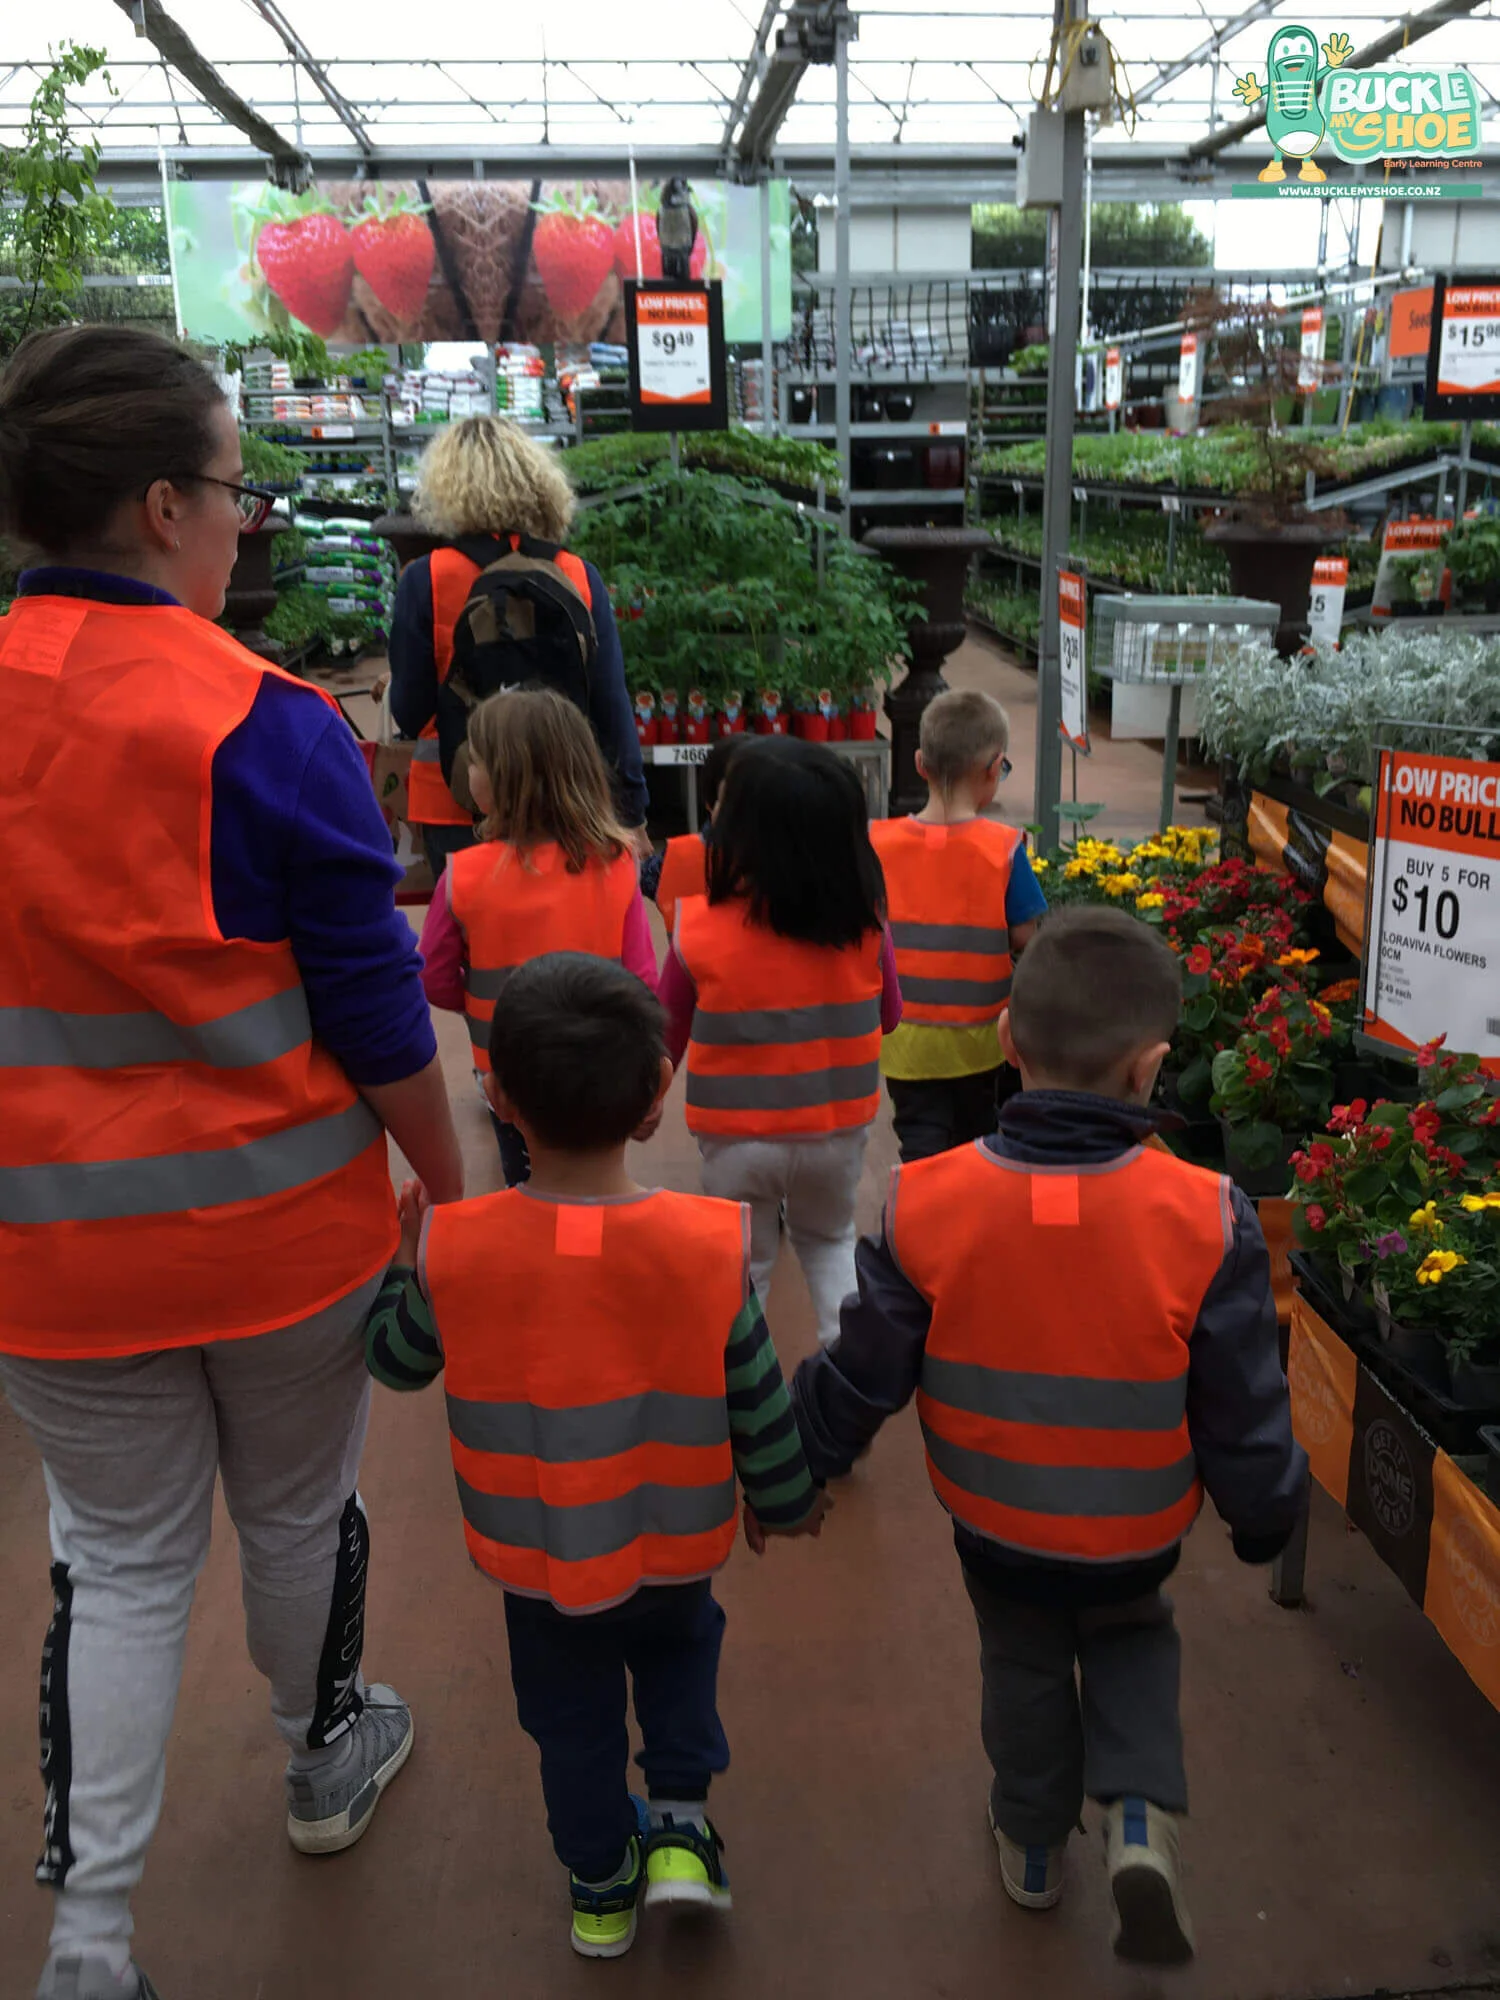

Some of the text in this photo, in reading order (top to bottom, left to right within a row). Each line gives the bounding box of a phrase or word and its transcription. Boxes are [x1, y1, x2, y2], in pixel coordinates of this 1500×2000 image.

[638, 296, 663, 309] LOW
[1384, 763, 1437, 798] LOW
[1401, 799, 1500, 842] NO BULL
[1406, 857, 1490, 892] BUY 5 FOR
[1392, 874, 1460, 940] $10
[1380, 946, 1402, 961] 0CM
[1382, 931, 1432, 955] LORAVIVA
[1433, 943, 1488, 969] FLOWERS
